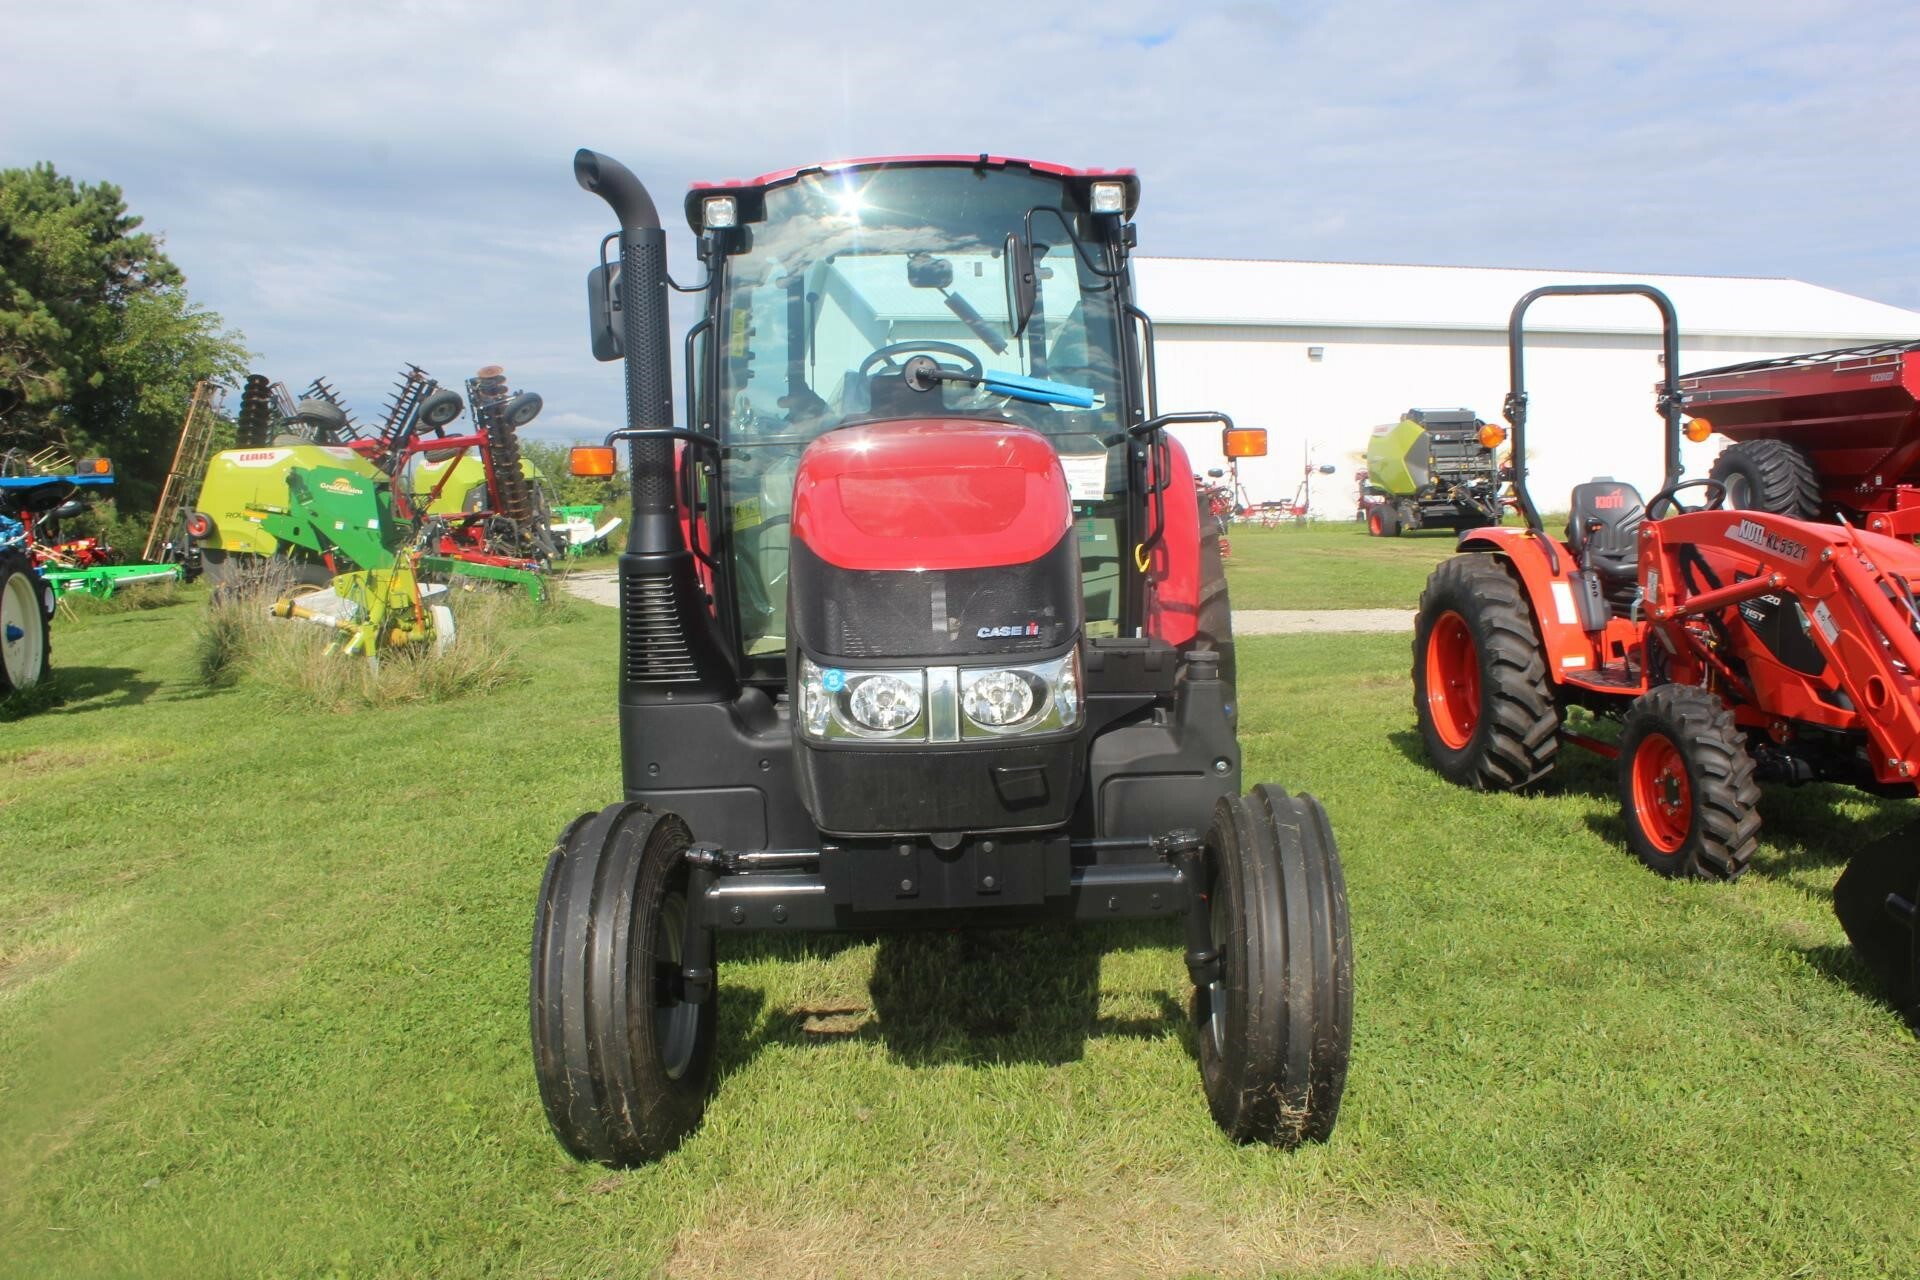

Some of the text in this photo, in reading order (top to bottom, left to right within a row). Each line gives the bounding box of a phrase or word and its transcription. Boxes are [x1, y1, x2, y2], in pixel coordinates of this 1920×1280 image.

[239, 452, 275, 461] CLAAS
[1595, 495, 1624, 509] KIOTI
[1739, 519, 1765, 545] KIOTI
[1745, 608, 1766, 621] HST
[977, 625, 1022, 638] CASE
